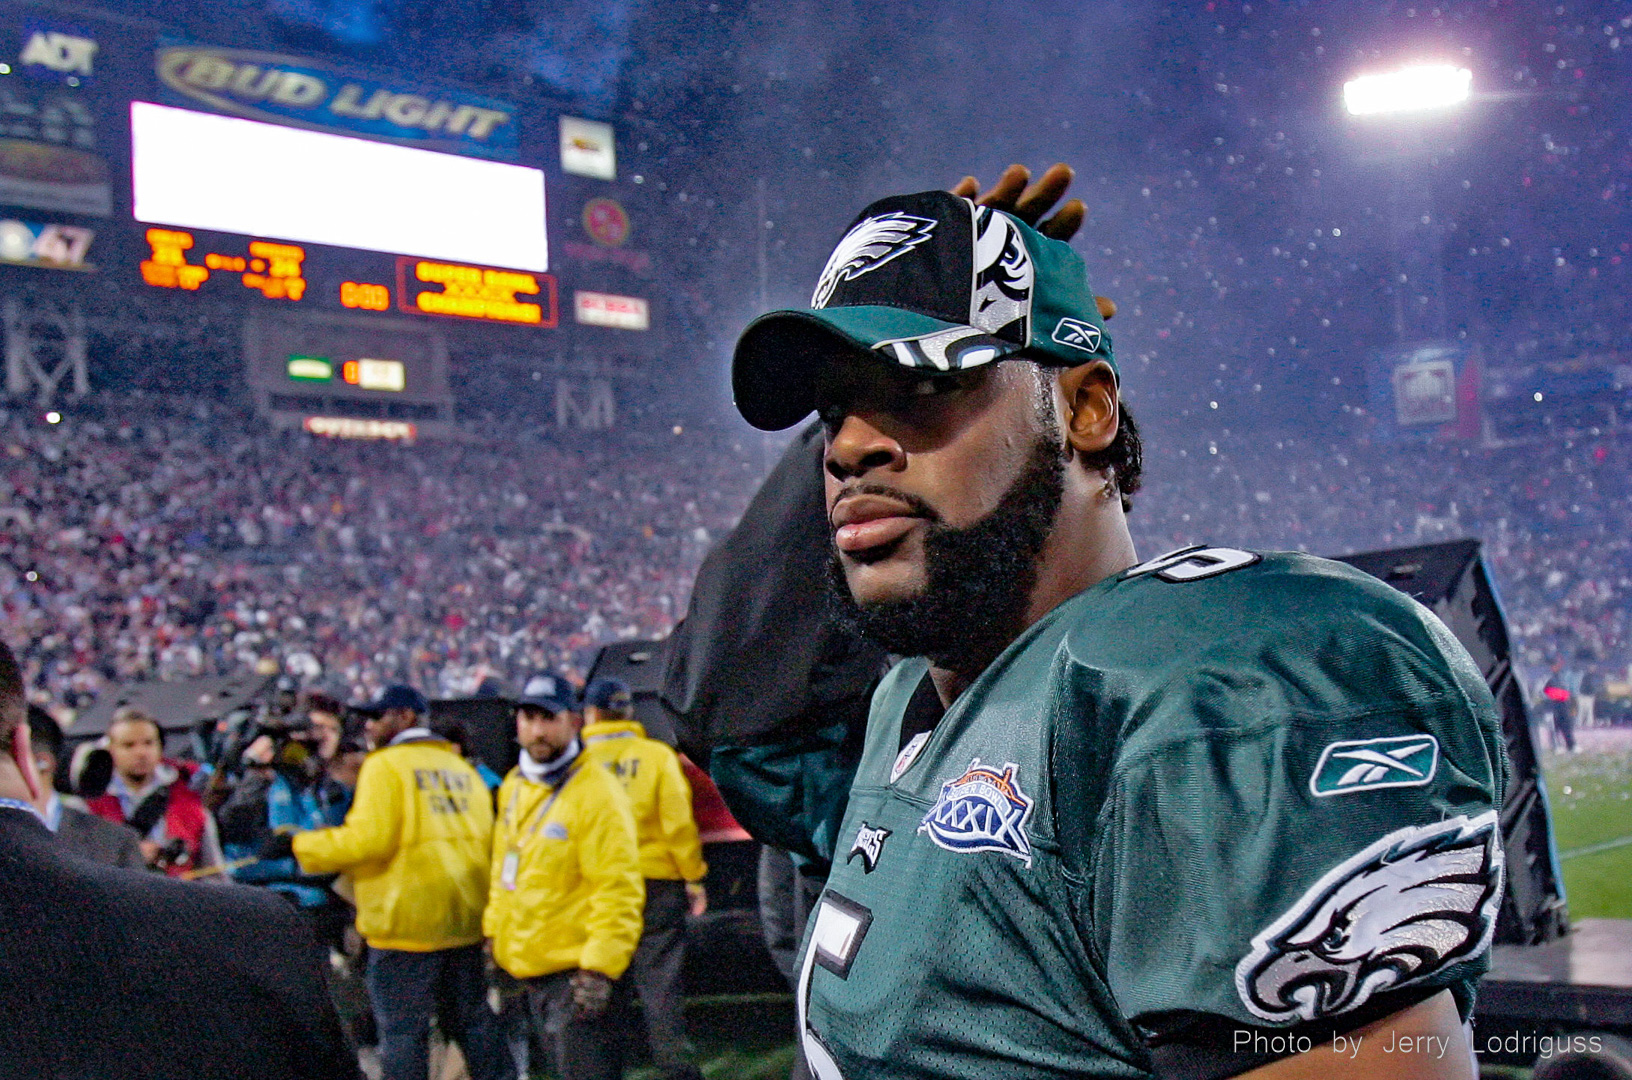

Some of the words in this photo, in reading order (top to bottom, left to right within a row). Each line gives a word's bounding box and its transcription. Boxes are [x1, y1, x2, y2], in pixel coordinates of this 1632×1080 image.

[20, 32, 98, 76] ADT
[176, 54, 327, 107] BUD
[329, 83, 510, 139] LIGHT
[978, 784, 1004, 812] BOWL
